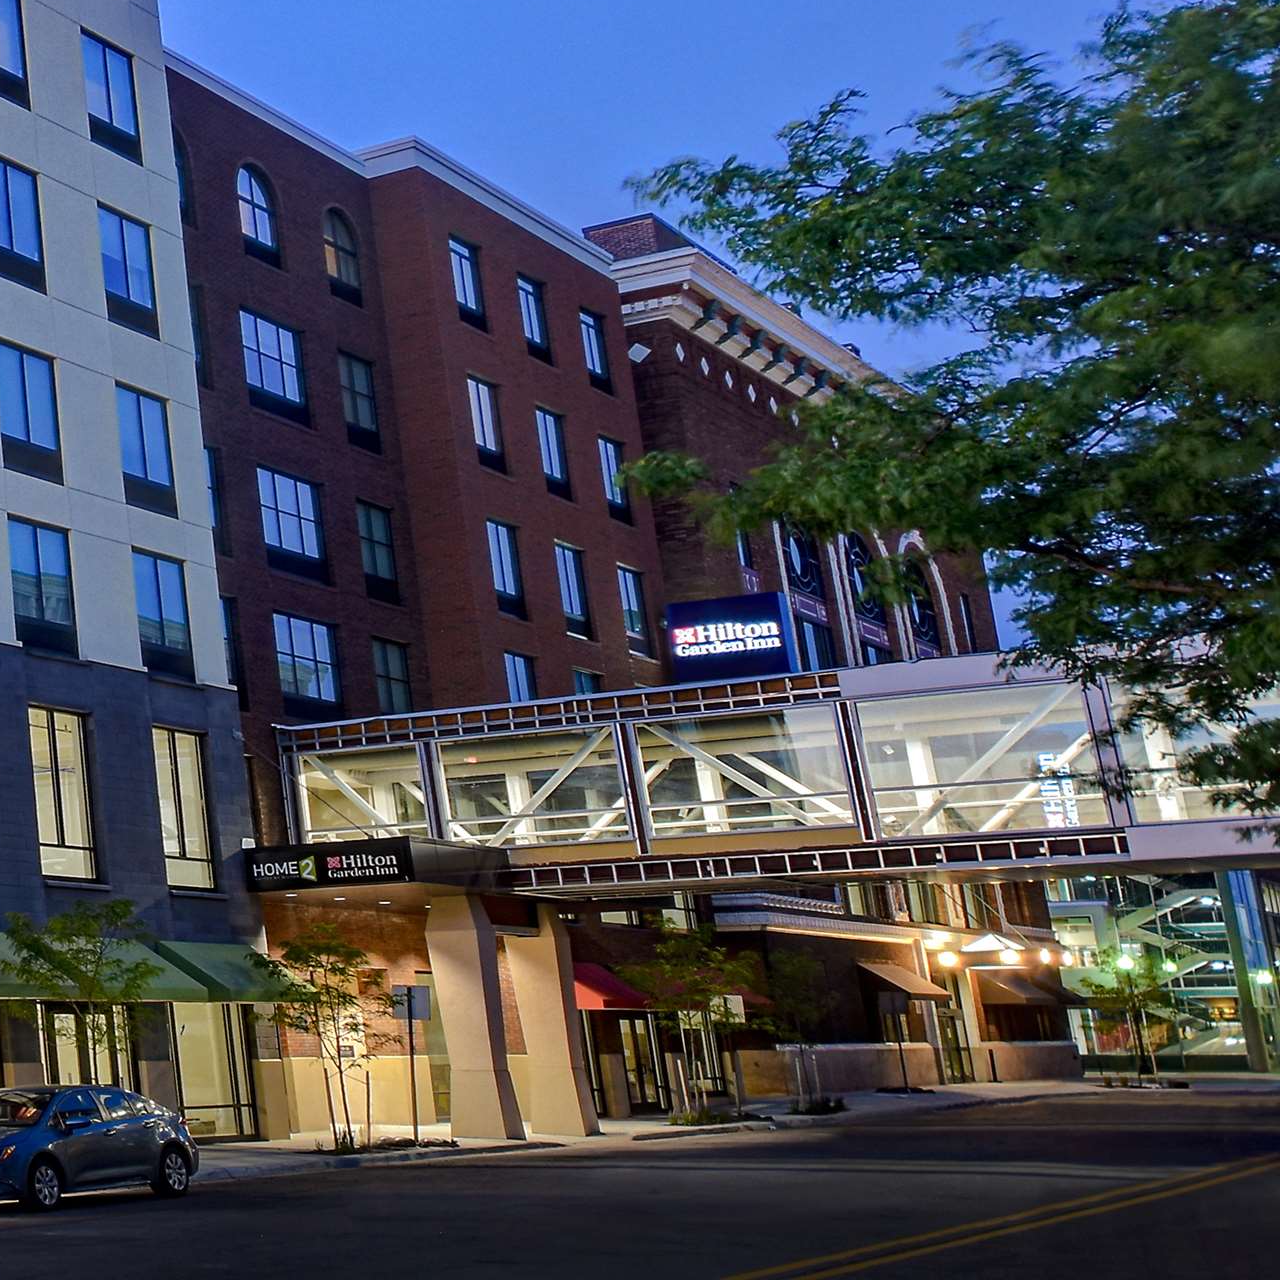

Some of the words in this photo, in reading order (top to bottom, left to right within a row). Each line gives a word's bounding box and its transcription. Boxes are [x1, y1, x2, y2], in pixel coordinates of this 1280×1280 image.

[697, 623, 780, 641] Hilton
[676, 641, 744, 656] Garden
[745, 638, 781, 650] Inn
[253, 861, 299, 877] HOME
[301, 859, 315, 879] 2
[342, 854, 397, 868] Hilton
[328, 867, 374, 879] Garden
[376, 866, 399, 876] Inn
